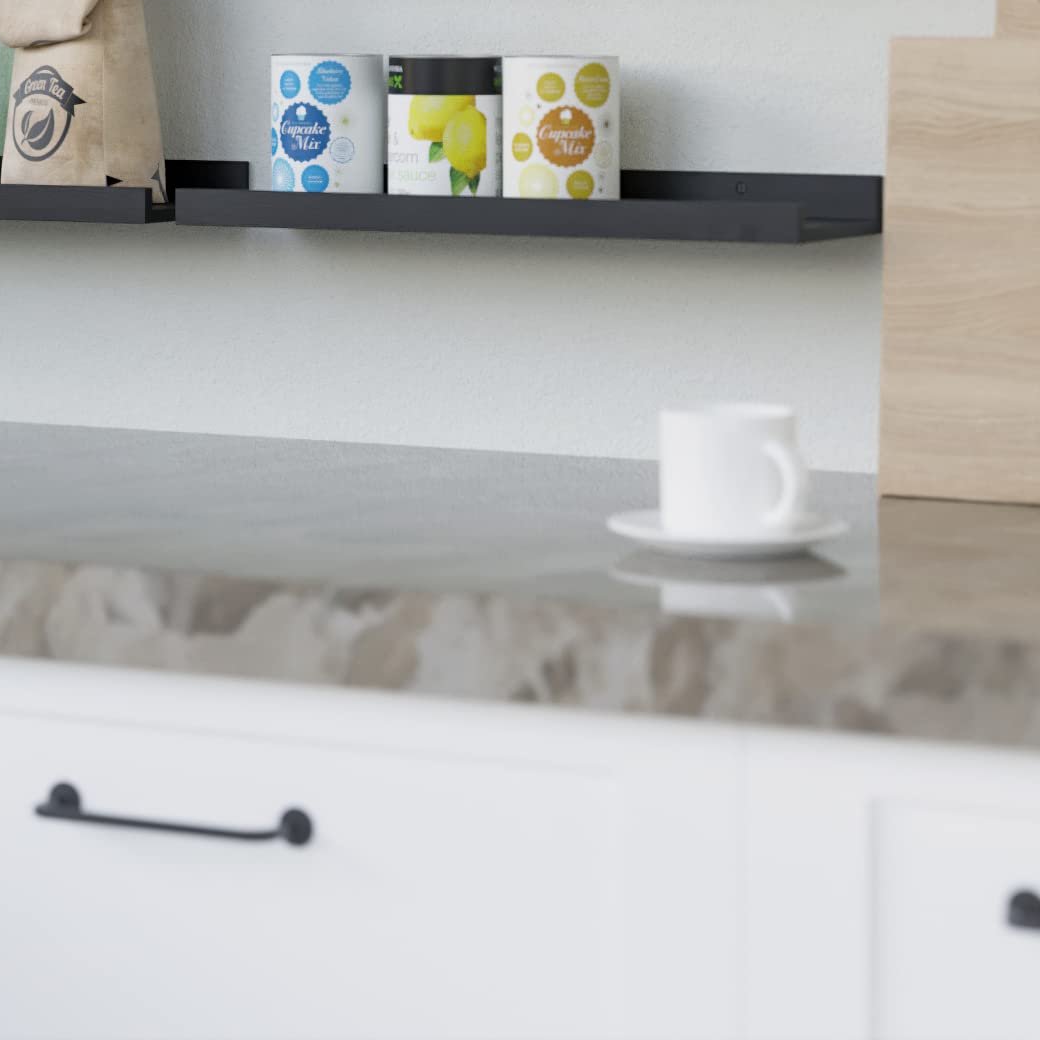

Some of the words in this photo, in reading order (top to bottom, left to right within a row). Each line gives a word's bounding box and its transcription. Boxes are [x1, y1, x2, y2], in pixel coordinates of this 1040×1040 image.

[24, 78, 47, 95] Green
[48, 77, 66, 100] Tea
[281, 120, 327, 138] Cupcake
[539, 124, 593, 143] Cupcake
[295, 134, 321, 150] Mix
[558, 140, 587, 156] Mix
